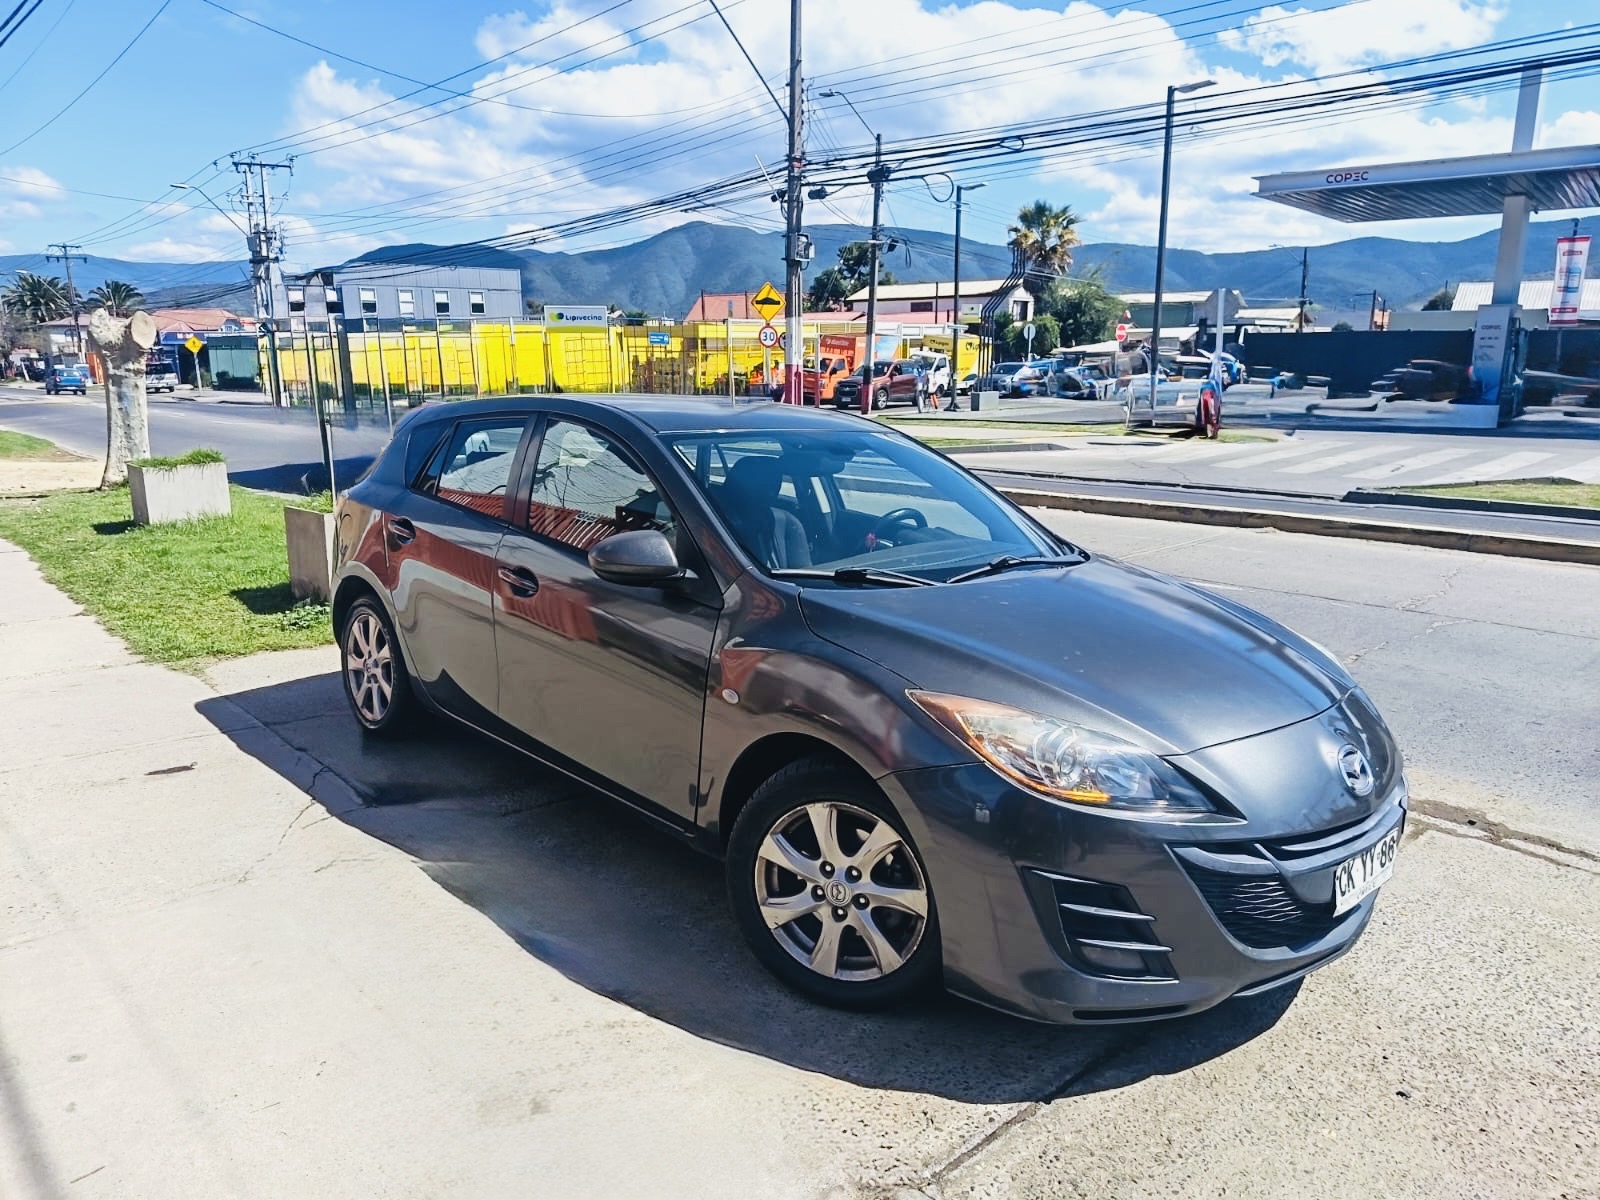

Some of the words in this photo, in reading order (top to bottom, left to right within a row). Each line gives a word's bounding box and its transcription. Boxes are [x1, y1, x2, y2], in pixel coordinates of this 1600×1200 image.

[1326, 171, 1369, 184] COPEC
[762, 331, 775, 342] 30
[1338, 857, 1356, 897] CK
[1361, 847, 1376, 882] YY
[1380, 835, 1396, 868] 86
